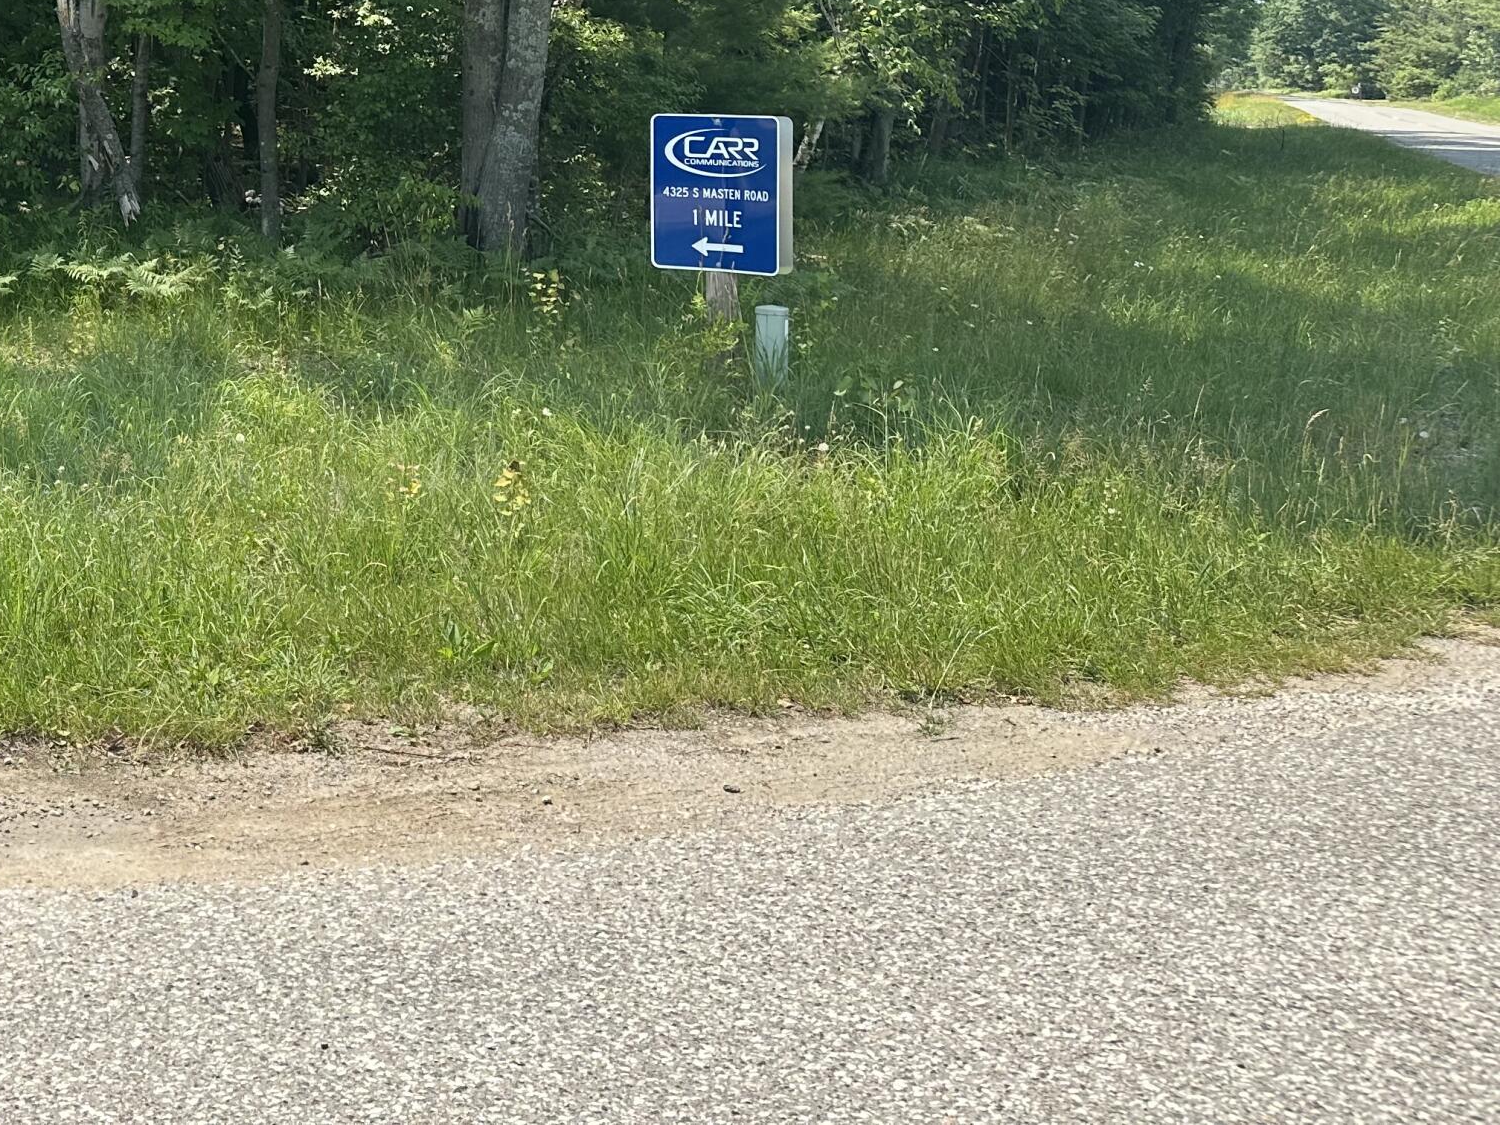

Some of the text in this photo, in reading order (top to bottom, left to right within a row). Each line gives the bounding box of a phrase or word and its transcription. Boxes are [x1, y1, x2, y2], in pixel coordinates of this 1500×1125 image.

[683, 136, 759, 160] CARR
[684, 158, 760, 168] COMMUNICATIONS
[662, 186, 769, 202] 4325 S MASTEN ROAD
[692, 208, 742, 228] 1 MILE
